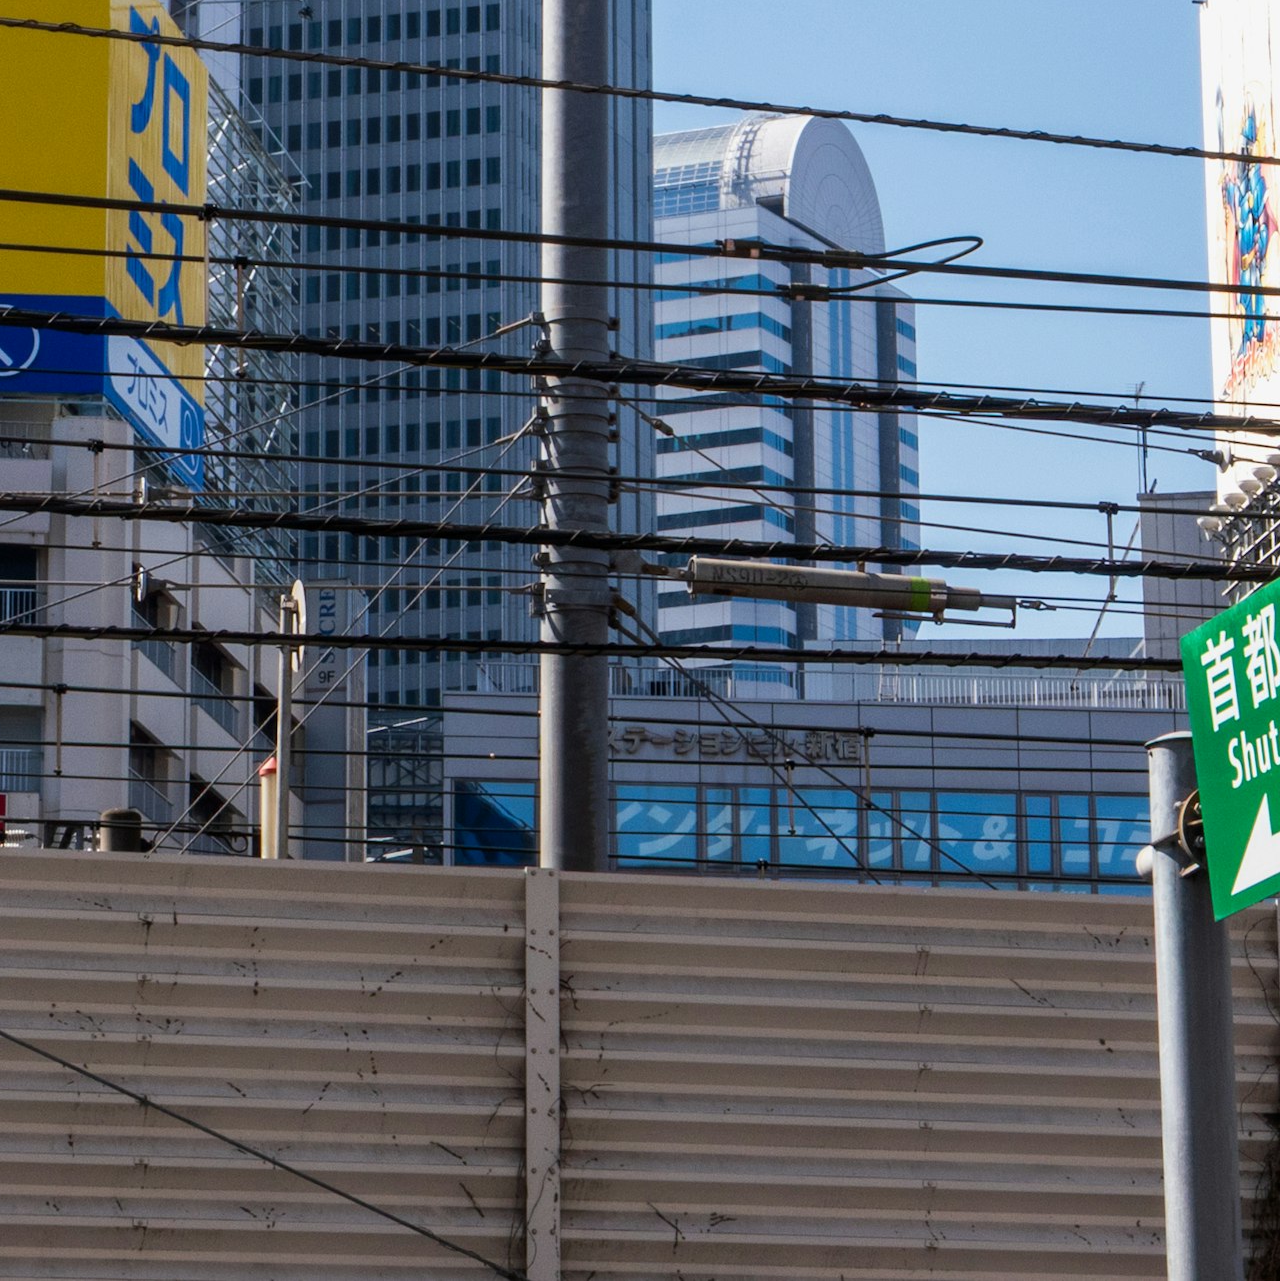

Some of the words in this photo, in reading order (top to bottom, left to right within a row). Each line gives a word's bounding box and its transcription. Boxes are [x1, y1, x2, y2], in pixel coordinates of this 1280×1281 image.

[130, 5, 190, 198] プロ
[125, 156, 184, 328] ミス
[127, 353, 169, 434] プロミス
[318, 670, 336, 684] 9F
[972, 815, 1018, 862] &
